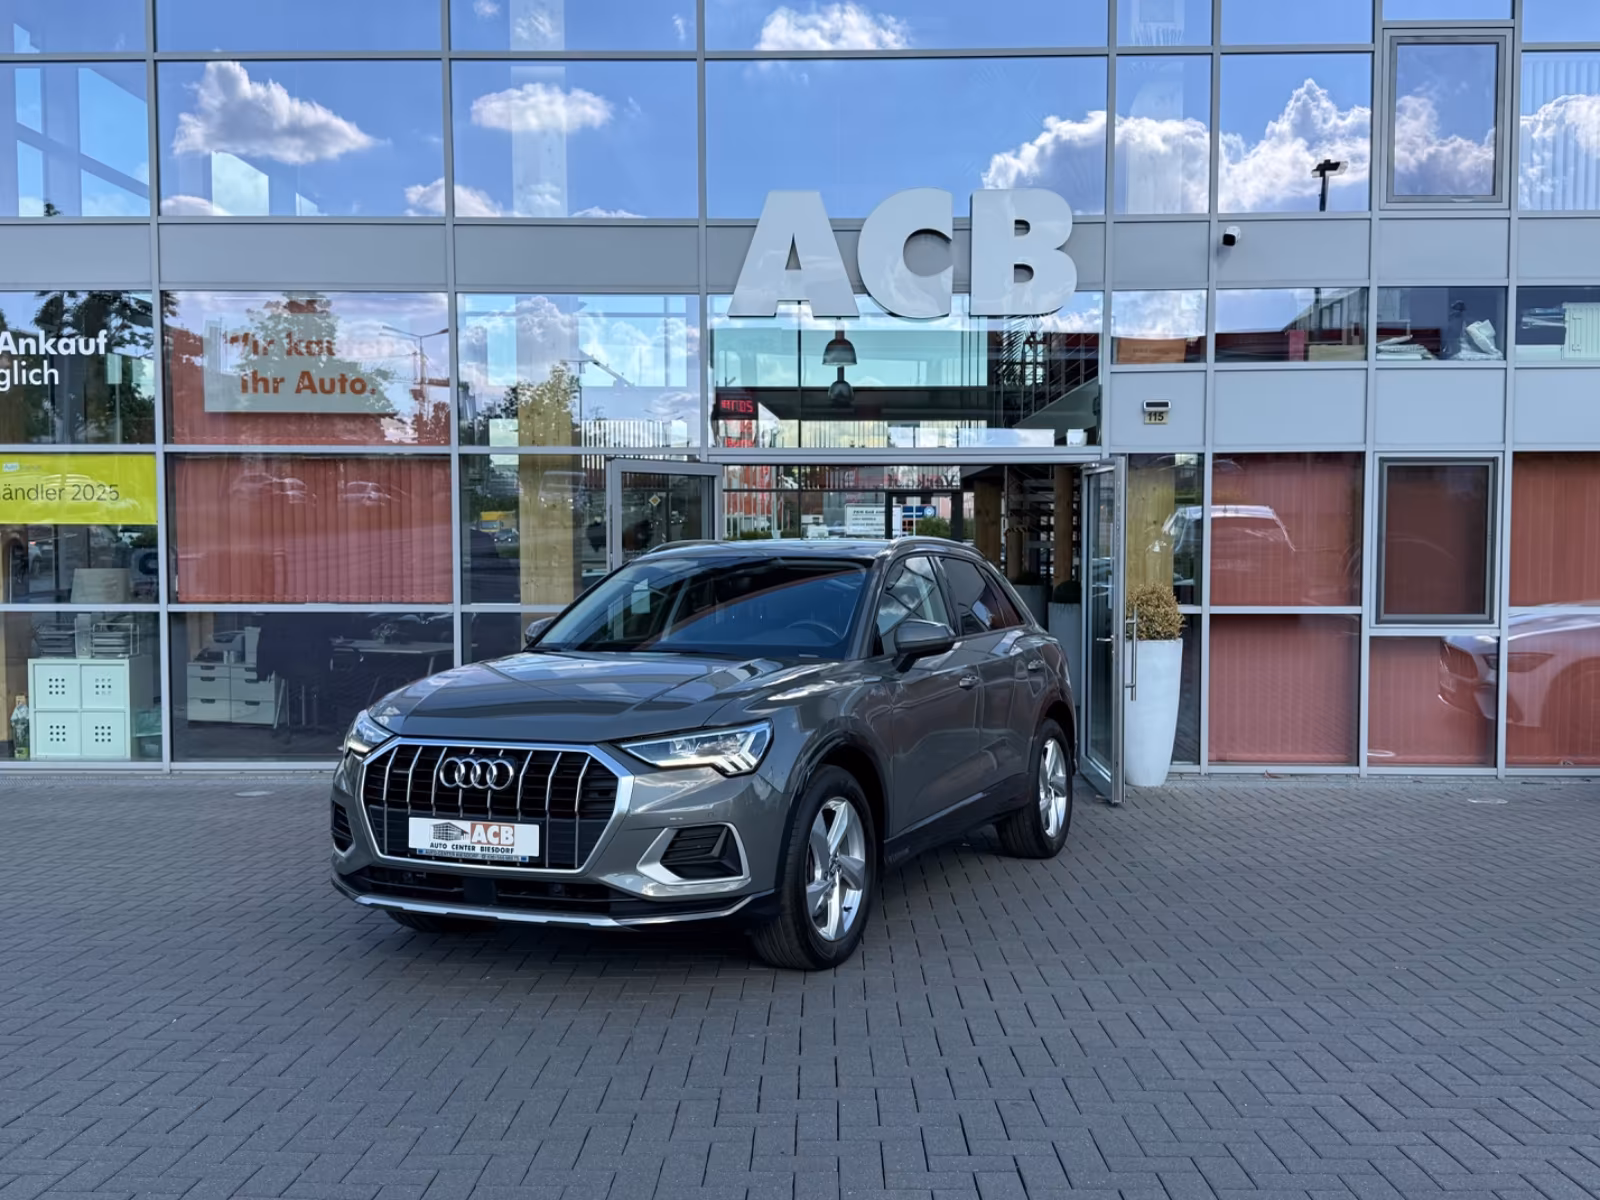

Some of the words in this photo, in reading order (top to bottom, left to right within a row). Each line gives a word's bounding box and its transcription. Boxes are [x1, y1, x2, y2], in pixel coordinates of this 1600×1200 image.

[727, 187, 1077, 319] ACB
[0, 329, 108, 355] Ankauf
[295, 370, 377, 395] Auto.
[1147, 411, 1164, 422] 115
[0, 482, 65, 501] ändler
[71, 483, 120, 501] 2025
[470, 823, 515, 846] ACB
[430, 842, 448, 850] AUTO
[451, 844, 476, 852] CENTER
[480, 846, 515, 854] BIESDORF
